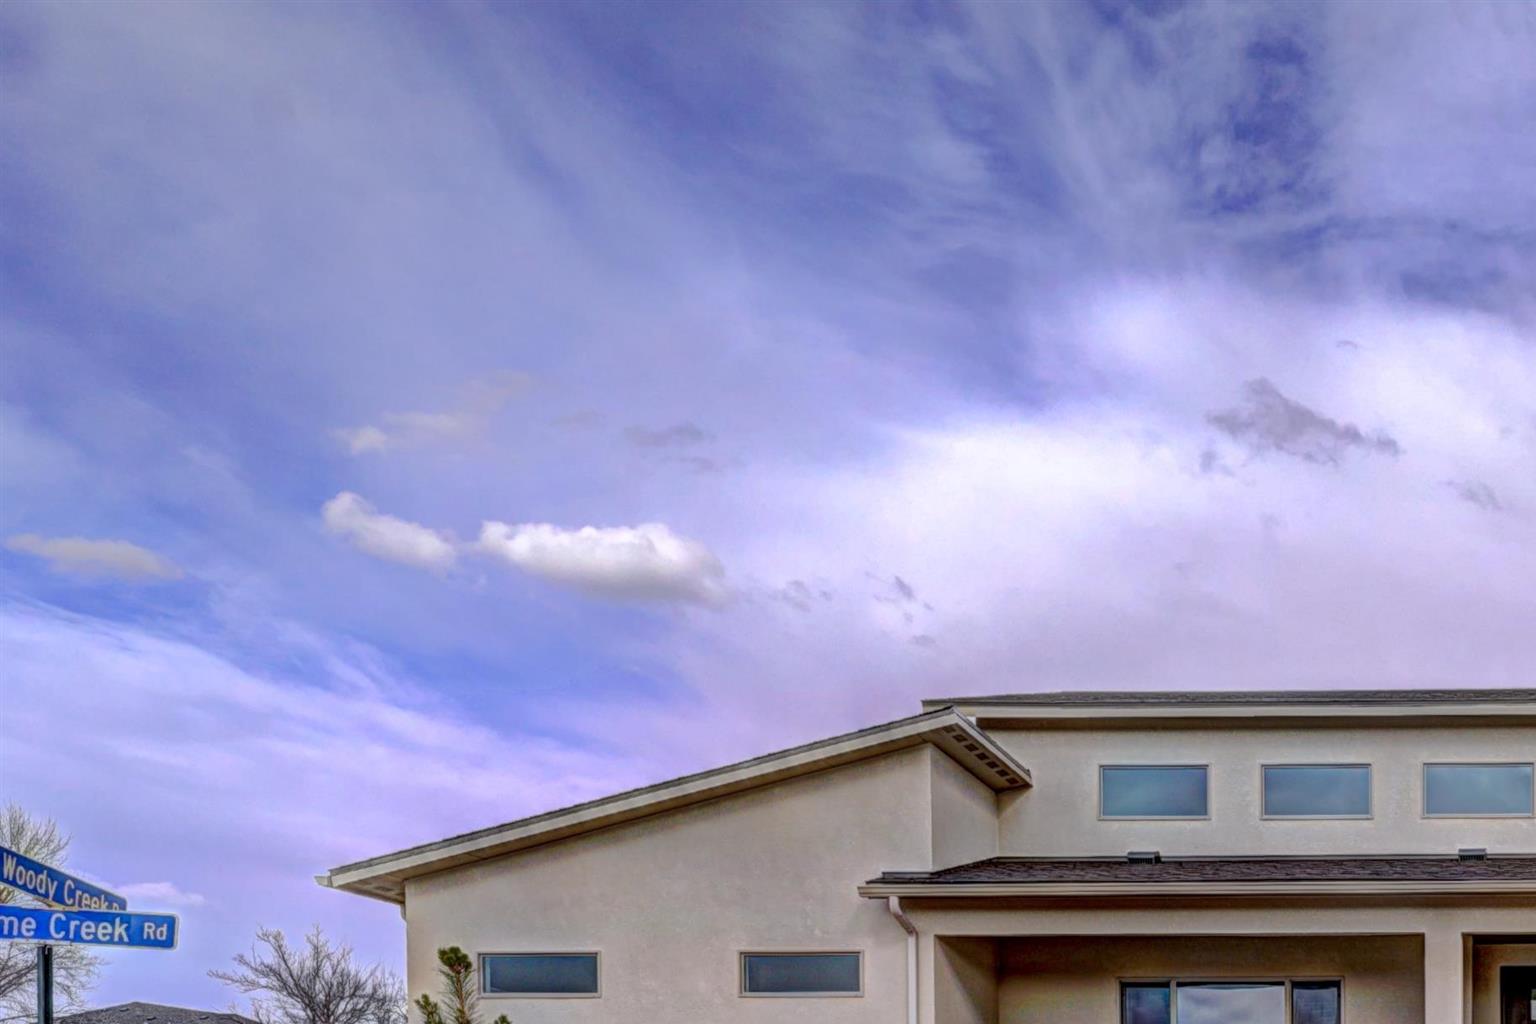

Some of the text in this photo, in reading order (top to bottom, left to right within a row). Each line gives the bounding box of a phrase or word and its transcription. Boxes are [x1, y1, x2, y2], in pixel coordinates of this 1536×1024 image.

[3, 852, 58, 901] Woody
[49, 912, 130, 943] Creek
[143, 921, 168, 941] Rd
